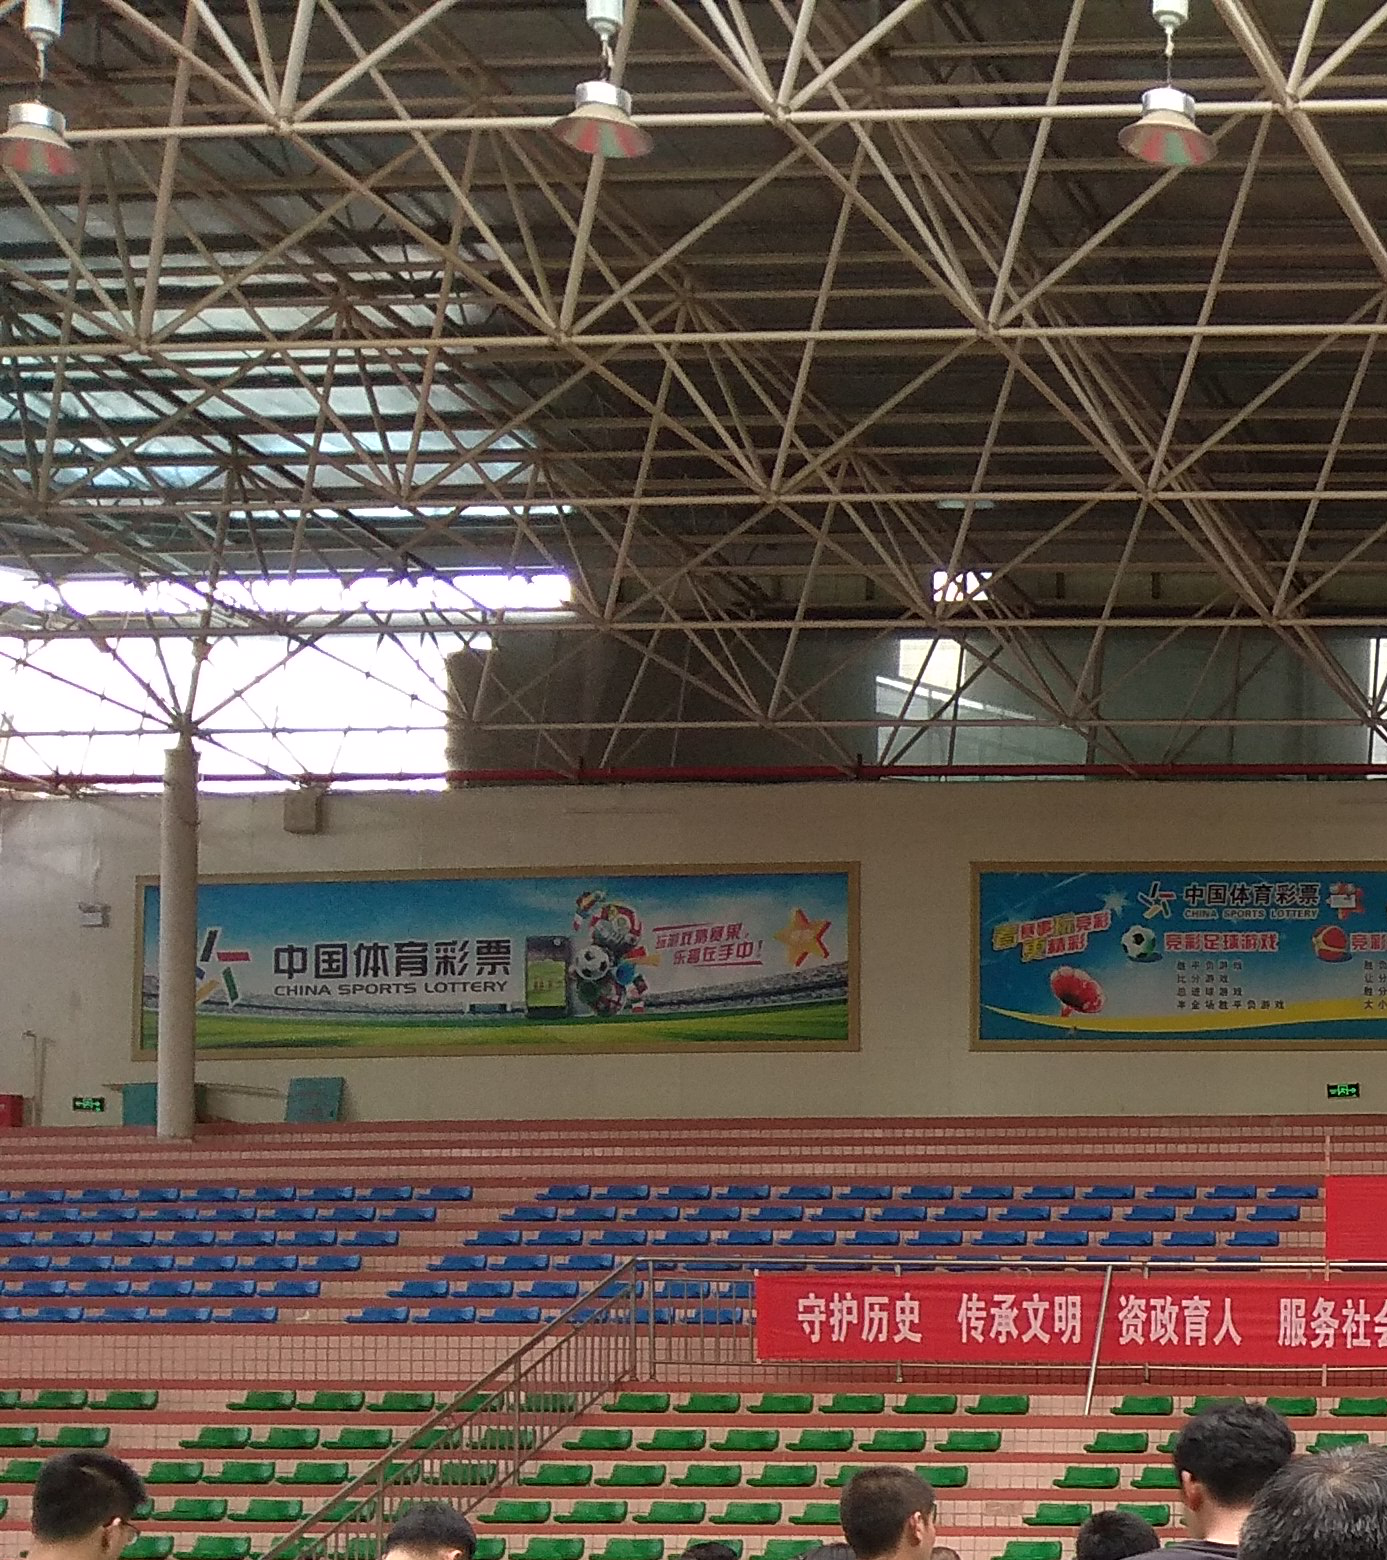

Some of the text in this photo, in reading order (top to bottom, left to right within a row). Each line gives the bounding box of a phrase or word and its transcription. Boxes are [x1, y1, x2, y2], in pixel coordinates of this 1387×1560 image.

[1185, 884, 1320, 905] 中国体育彩票
[1184, 908, 1319, 919] CHINA SPORTS LOTTERY
[1165, 933, 1279, 951] 竞彩足球游戏
[273, 939, 511, 979] 中国体育彩票
[274, 981, 508, 996] CHINA SPORTS LOTTERY
[797, 1293, 922, 1343] 守护历史
[957, 1293, 1082, 1344] 传承文明
[1118, 1295, 1243, 1347] 资政育人
